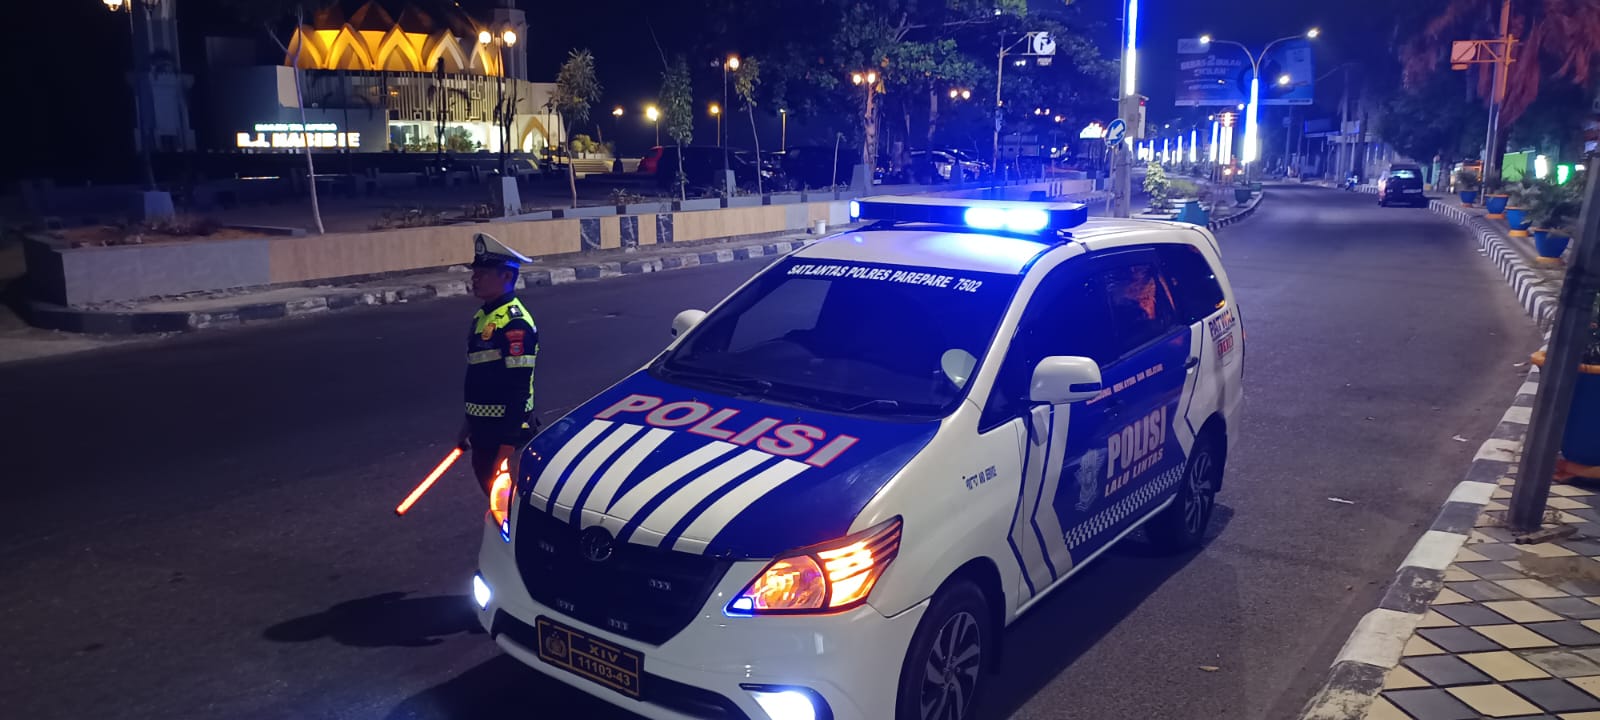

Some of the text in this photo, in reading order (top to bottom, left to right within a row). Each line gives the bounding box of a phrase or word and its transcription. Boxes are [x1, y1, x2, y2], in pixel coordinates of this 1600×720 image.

[787, 264, 983, 293] SATLANTAS POLRES PAREPARE 7502
[593, 394, 860, 468] POLISI
[1107, 405, 1167, 479] POLISI
[1104, 447, 1164, 497] LALU LINTAS
[578, 655, 631, 686] 11103-43
[589, 643, 618, 663] XIV
